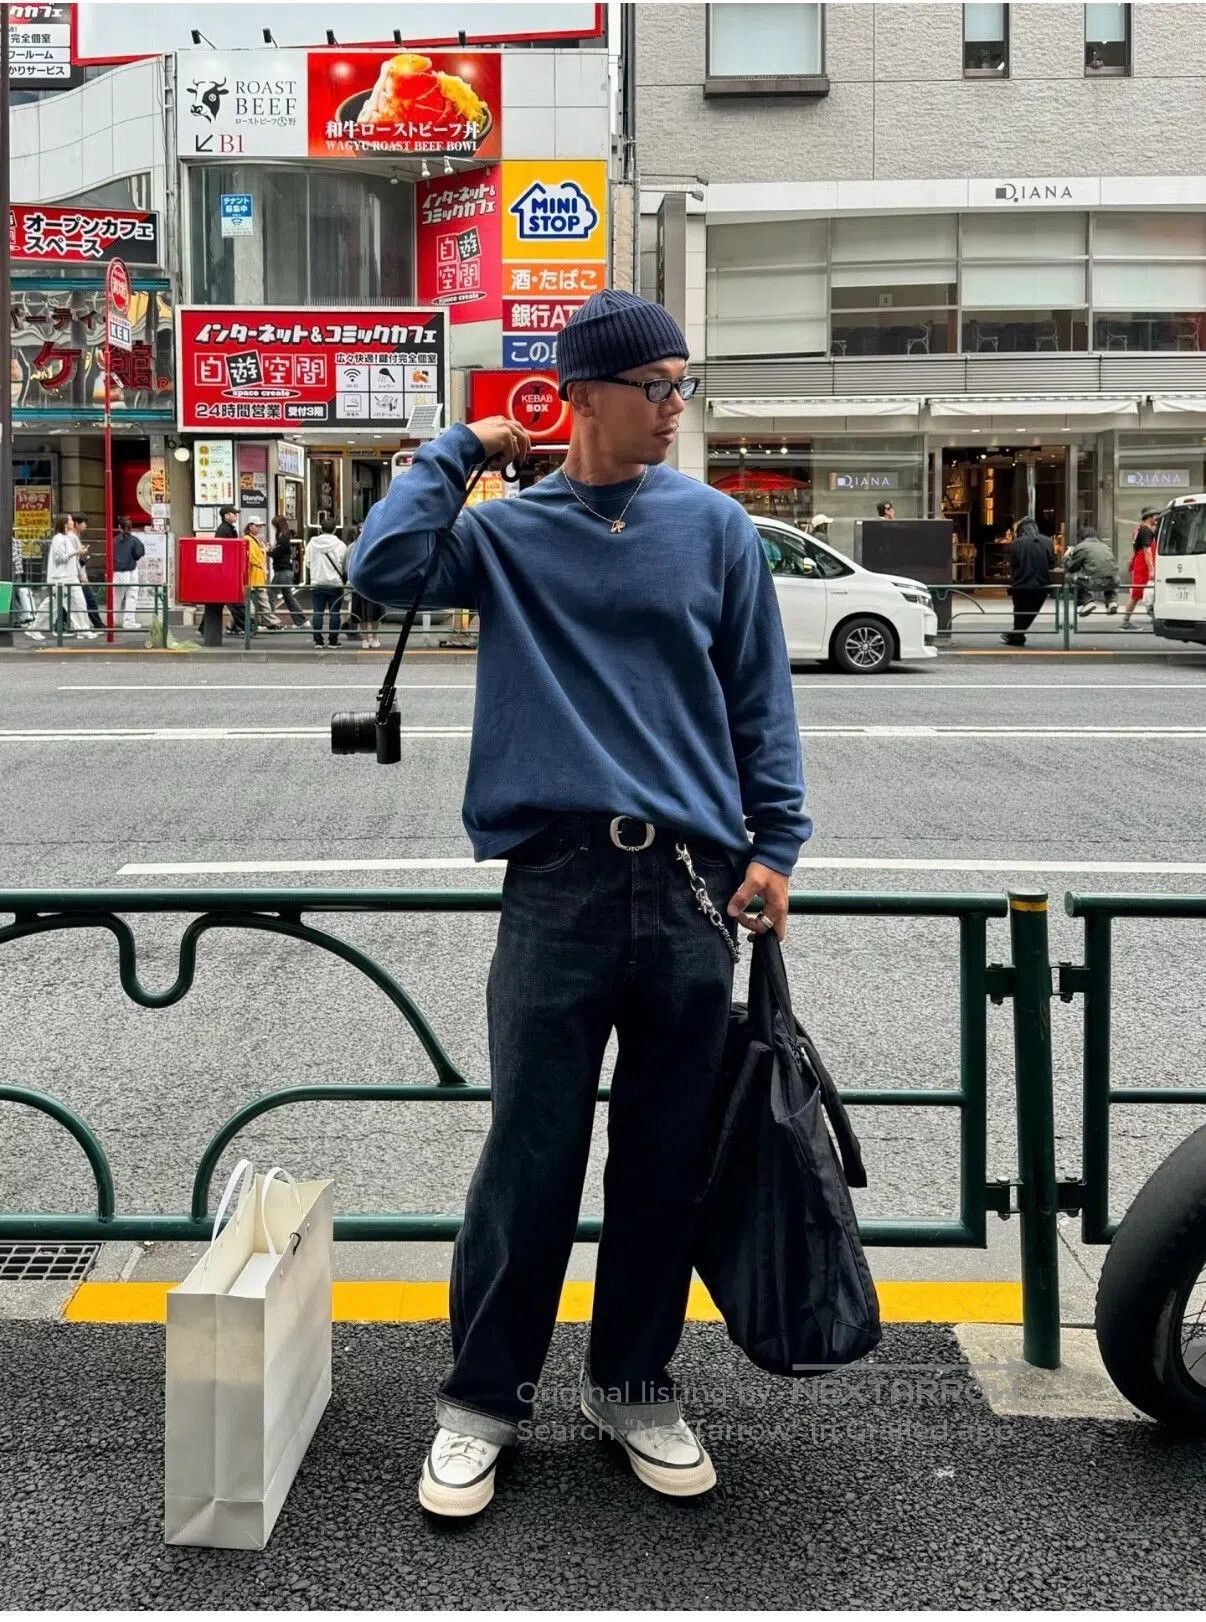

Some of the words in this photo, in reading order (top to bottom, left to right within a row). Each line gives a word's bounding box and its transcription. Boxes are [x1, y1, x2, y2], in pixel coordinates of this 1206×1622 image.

[10, 33, 51, 44] 完全個室
[235, 80, 297, 94] ROAST
[235, 97, 297, 115] BEEF
[326, 119, 480, 140] 和牛ローストビーフ丼
[219, 134, 244, 153] B1
[326, 140, 371, 151] WAGYU
[371, 140, 411, 151] ROAST
[413, 140, 443, 151] BEEF
[447, 140, 478, 151] BOWL
[995, 183, 1073, 203] DIANA
[422, 199, 496, 224] コミックカフェ
[531, 197, 578, 214] MINI
[25, 214, 154, 239] オープンカフェ
[528, 215, 581, 232] STOP
[25, 235, 103, 256] スペース
[511, 268, 598, 290] 酒・たばこ
[195, 323, 437, 344] インターネット&コミックカフェ
[197, 353, 327, 387] 自遊空間
[233, 389, 259, 397] space
[261, 389, 290, 397] create
[521, 394, 553, 403] KEBAB
[196, 404, 281, 418] 24時間営業
[526, 403, 549, 412] BOX
[837, 474, 890, 488] DIANA
[1127, 471, 1181, 486] DIANA
